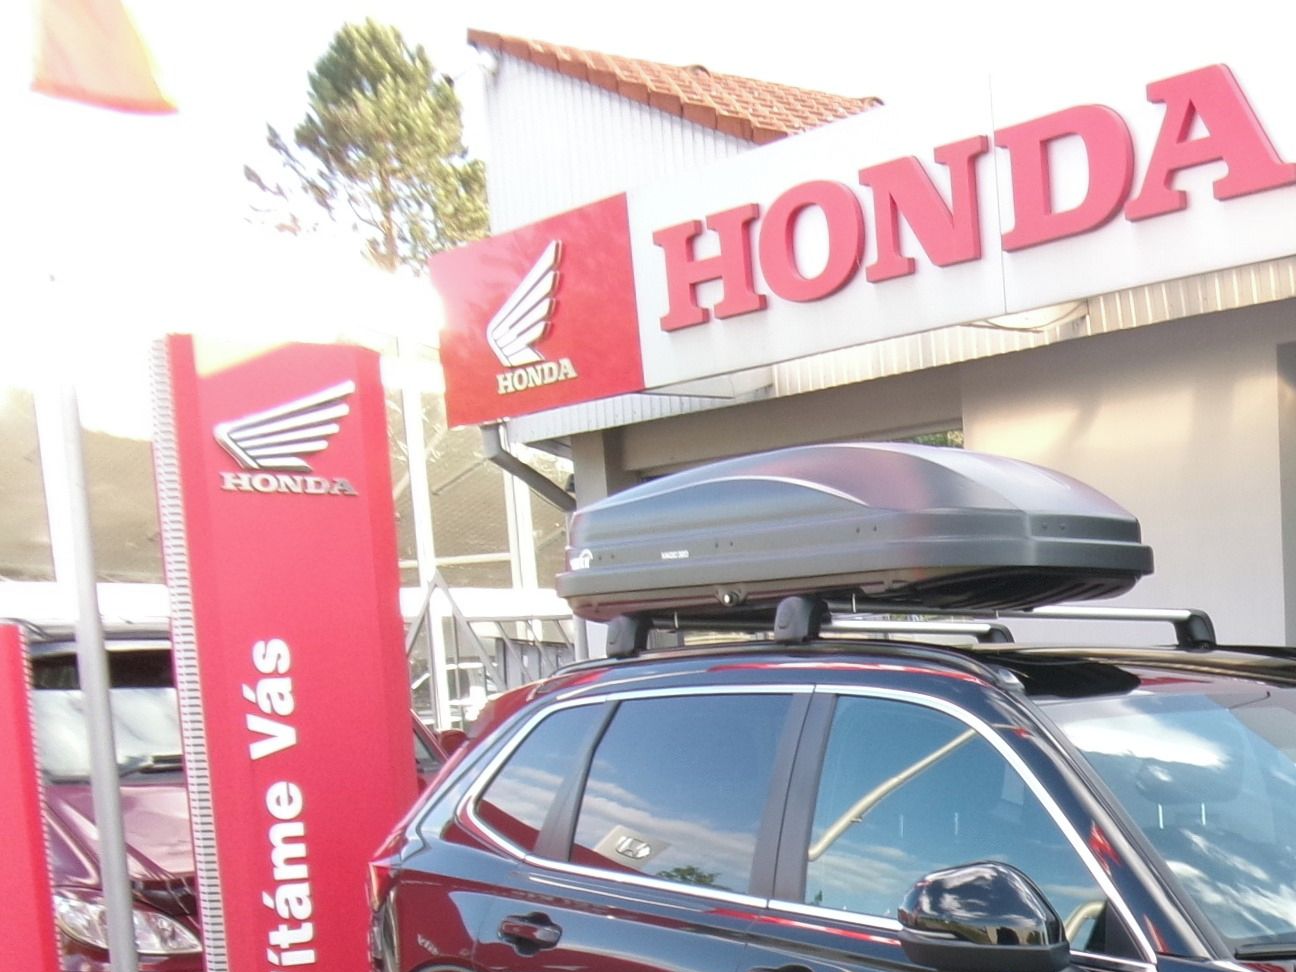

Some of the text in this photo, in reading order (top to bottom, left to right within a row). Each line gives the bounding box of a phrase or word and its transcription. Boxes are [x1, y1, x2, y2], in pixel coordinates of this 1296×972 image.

[496, 358, 578, 395] HONDA
[219, 471, 359, 496] HONDA
[242, 637, 298, 761] Vás
